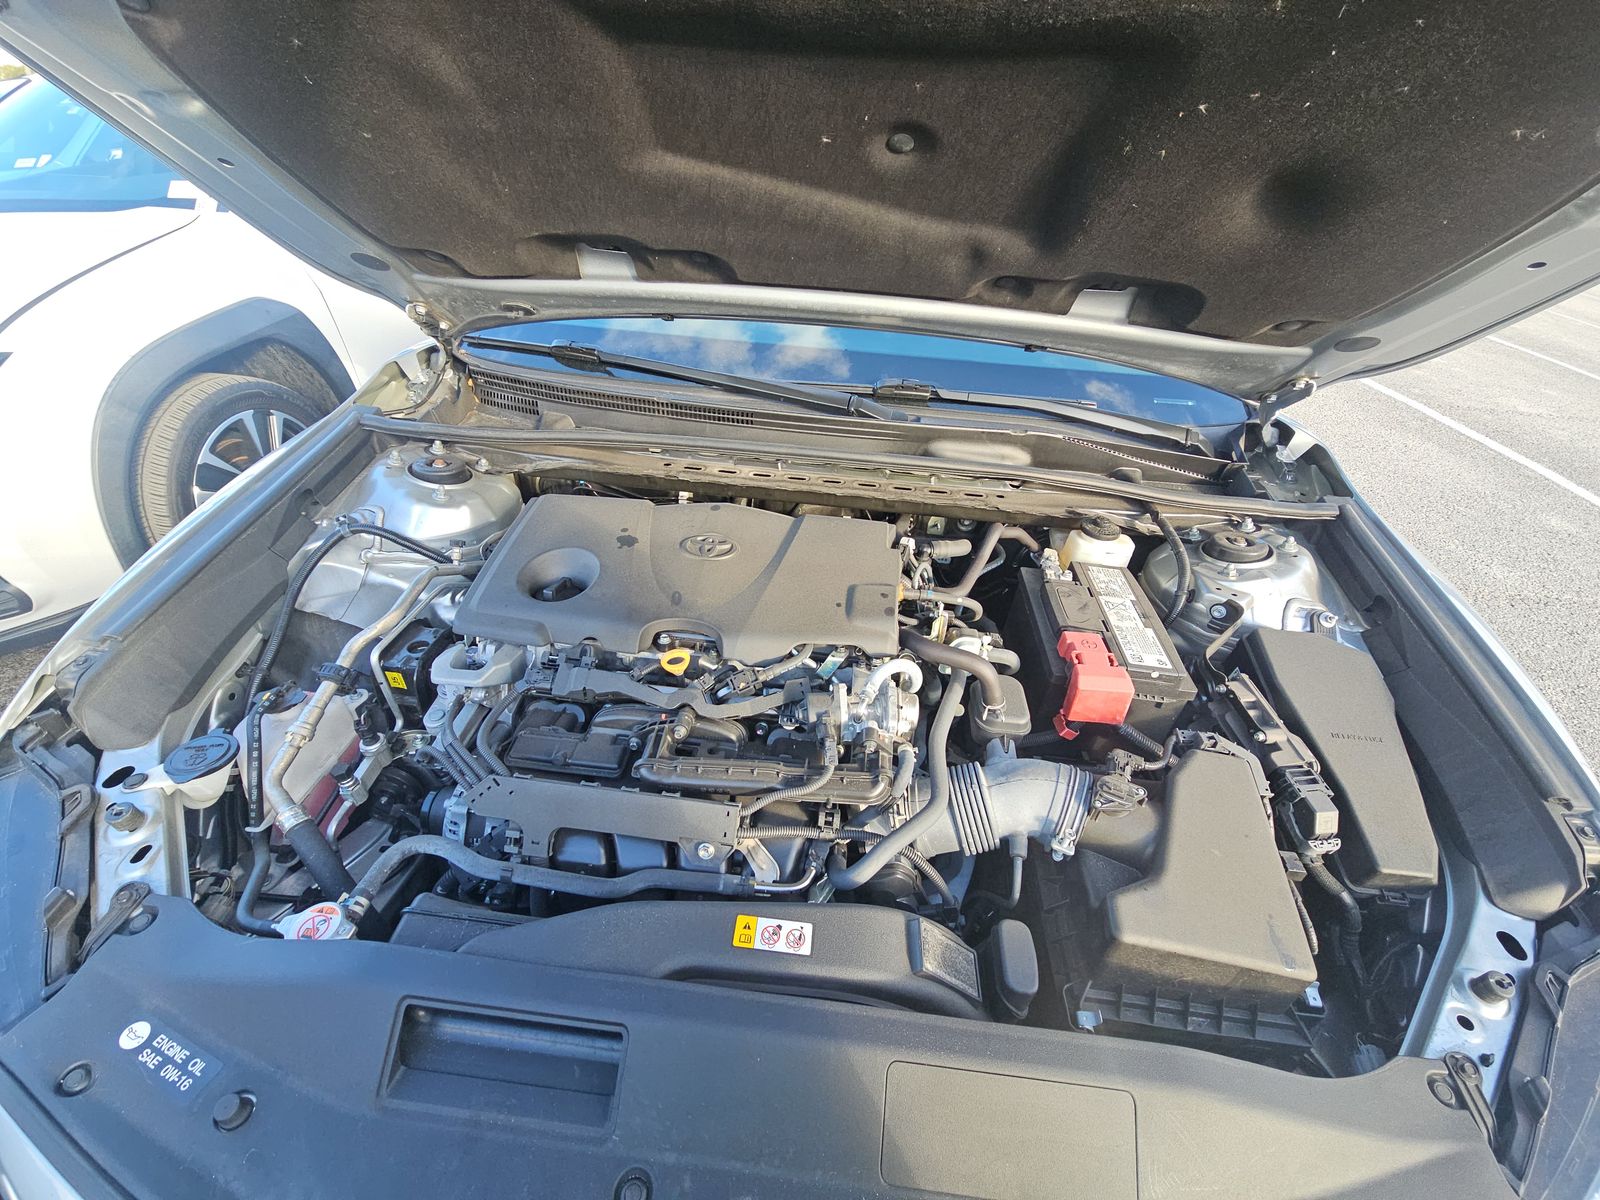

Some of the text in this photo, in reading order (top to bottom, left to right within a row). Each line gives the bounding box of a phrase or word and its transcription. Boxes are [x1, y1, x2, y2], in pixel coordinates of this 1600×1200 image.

[138, 1048, 193, 1091] SAE 0W-16
[152, 1034, 206, 1077] ENGINE OIL
